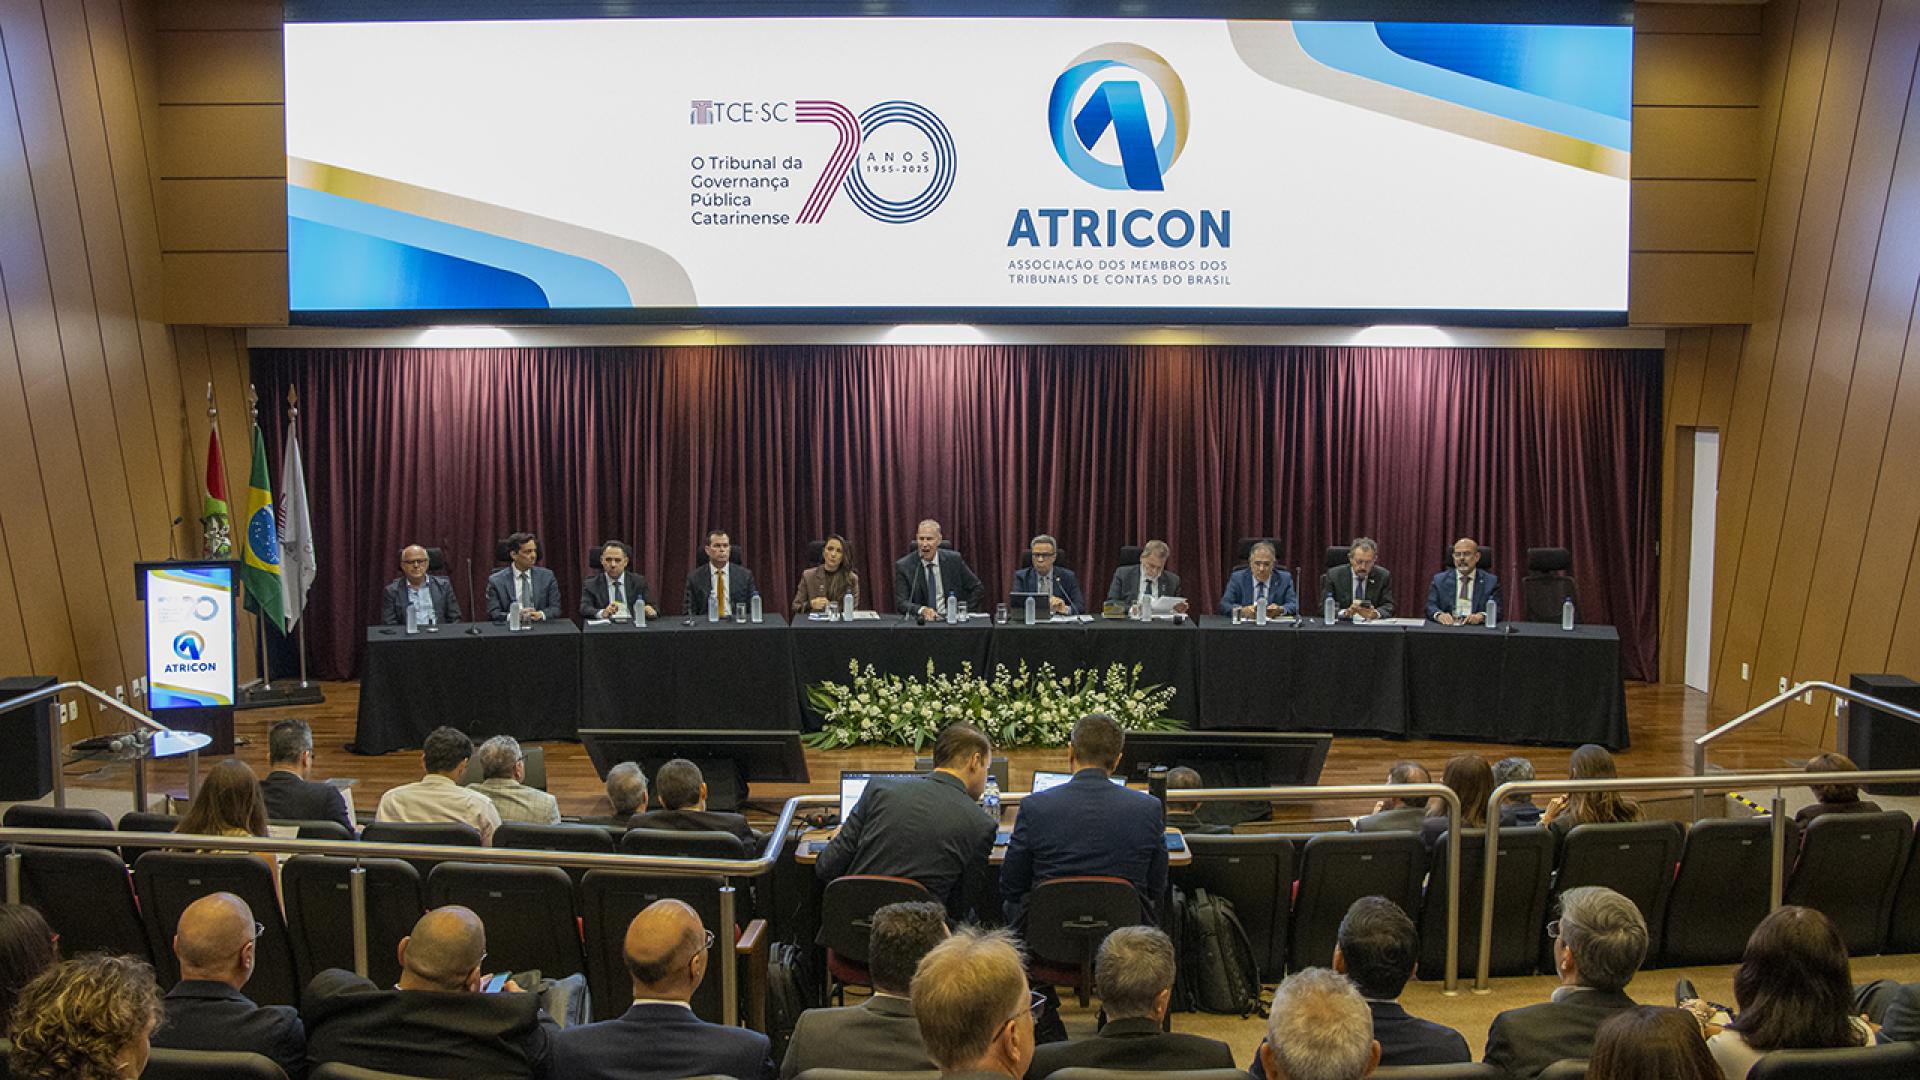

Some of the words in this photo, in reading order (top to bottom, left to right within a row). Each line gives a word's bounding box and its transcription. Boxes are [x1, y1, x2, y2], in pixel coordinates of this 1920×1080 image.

[691, 156, 705, 171] O
[708, 155, 776, 171] Tribunal
[781, 155, 803, 171] da
[866, 152, 930, 163] ANOS
[866, 165, 930, 174] 1955-2025
[690, 175, 791, 191] Governança
[690, 192, 752, 208] Pública
[690, 210, 791, 226] Catarinense
[1007, 208, 1231, 249] ATRICON
[1007, 259, 1094, 272] ASSOCIAÇÃO
[1098, 260, 1126, 271] DOS
[1130, 260, 1196, 271] MEMBROS
[1200, 260, 1228, 271] DOS
[1008, 274, 1079, 285] TRIBUNAIS
[1083, 274, 1100, 285] DE
[1104, 274, 1158, 285] CONTAS
[1162, 274, 1183, 285] DO
[1187, 274, 1232, 286] BRASIL
[164, 663, 217, 673] ATRICON
